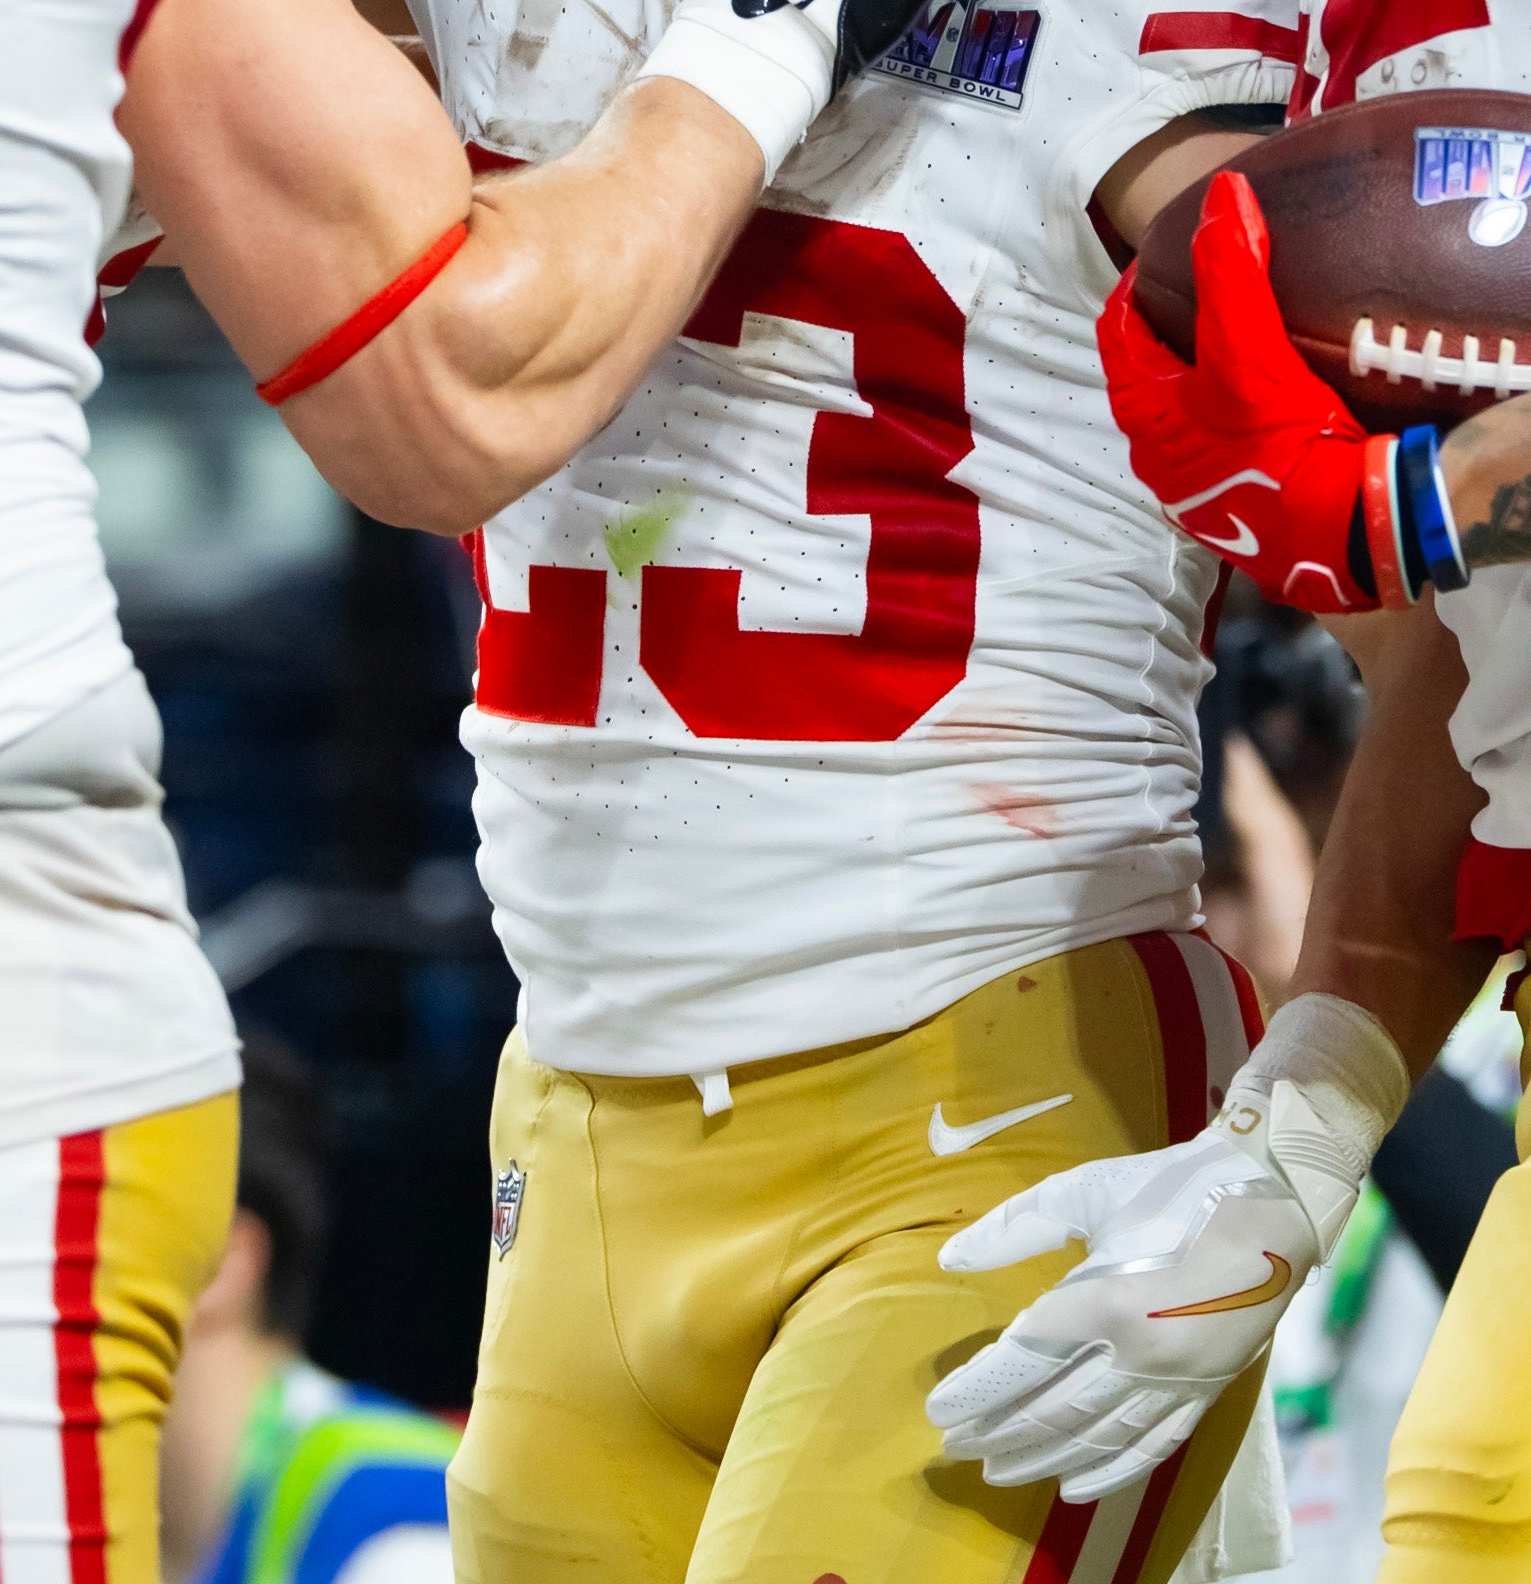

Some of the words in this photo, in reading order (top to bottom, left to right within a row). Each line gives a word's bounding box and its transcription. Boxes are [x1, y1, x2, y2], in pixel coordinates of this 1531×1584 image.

[876, 59, 938, 83] SUPER
[948, 78, 1007, 102] BOWL
[885, 1, 1042, 95] VIII
